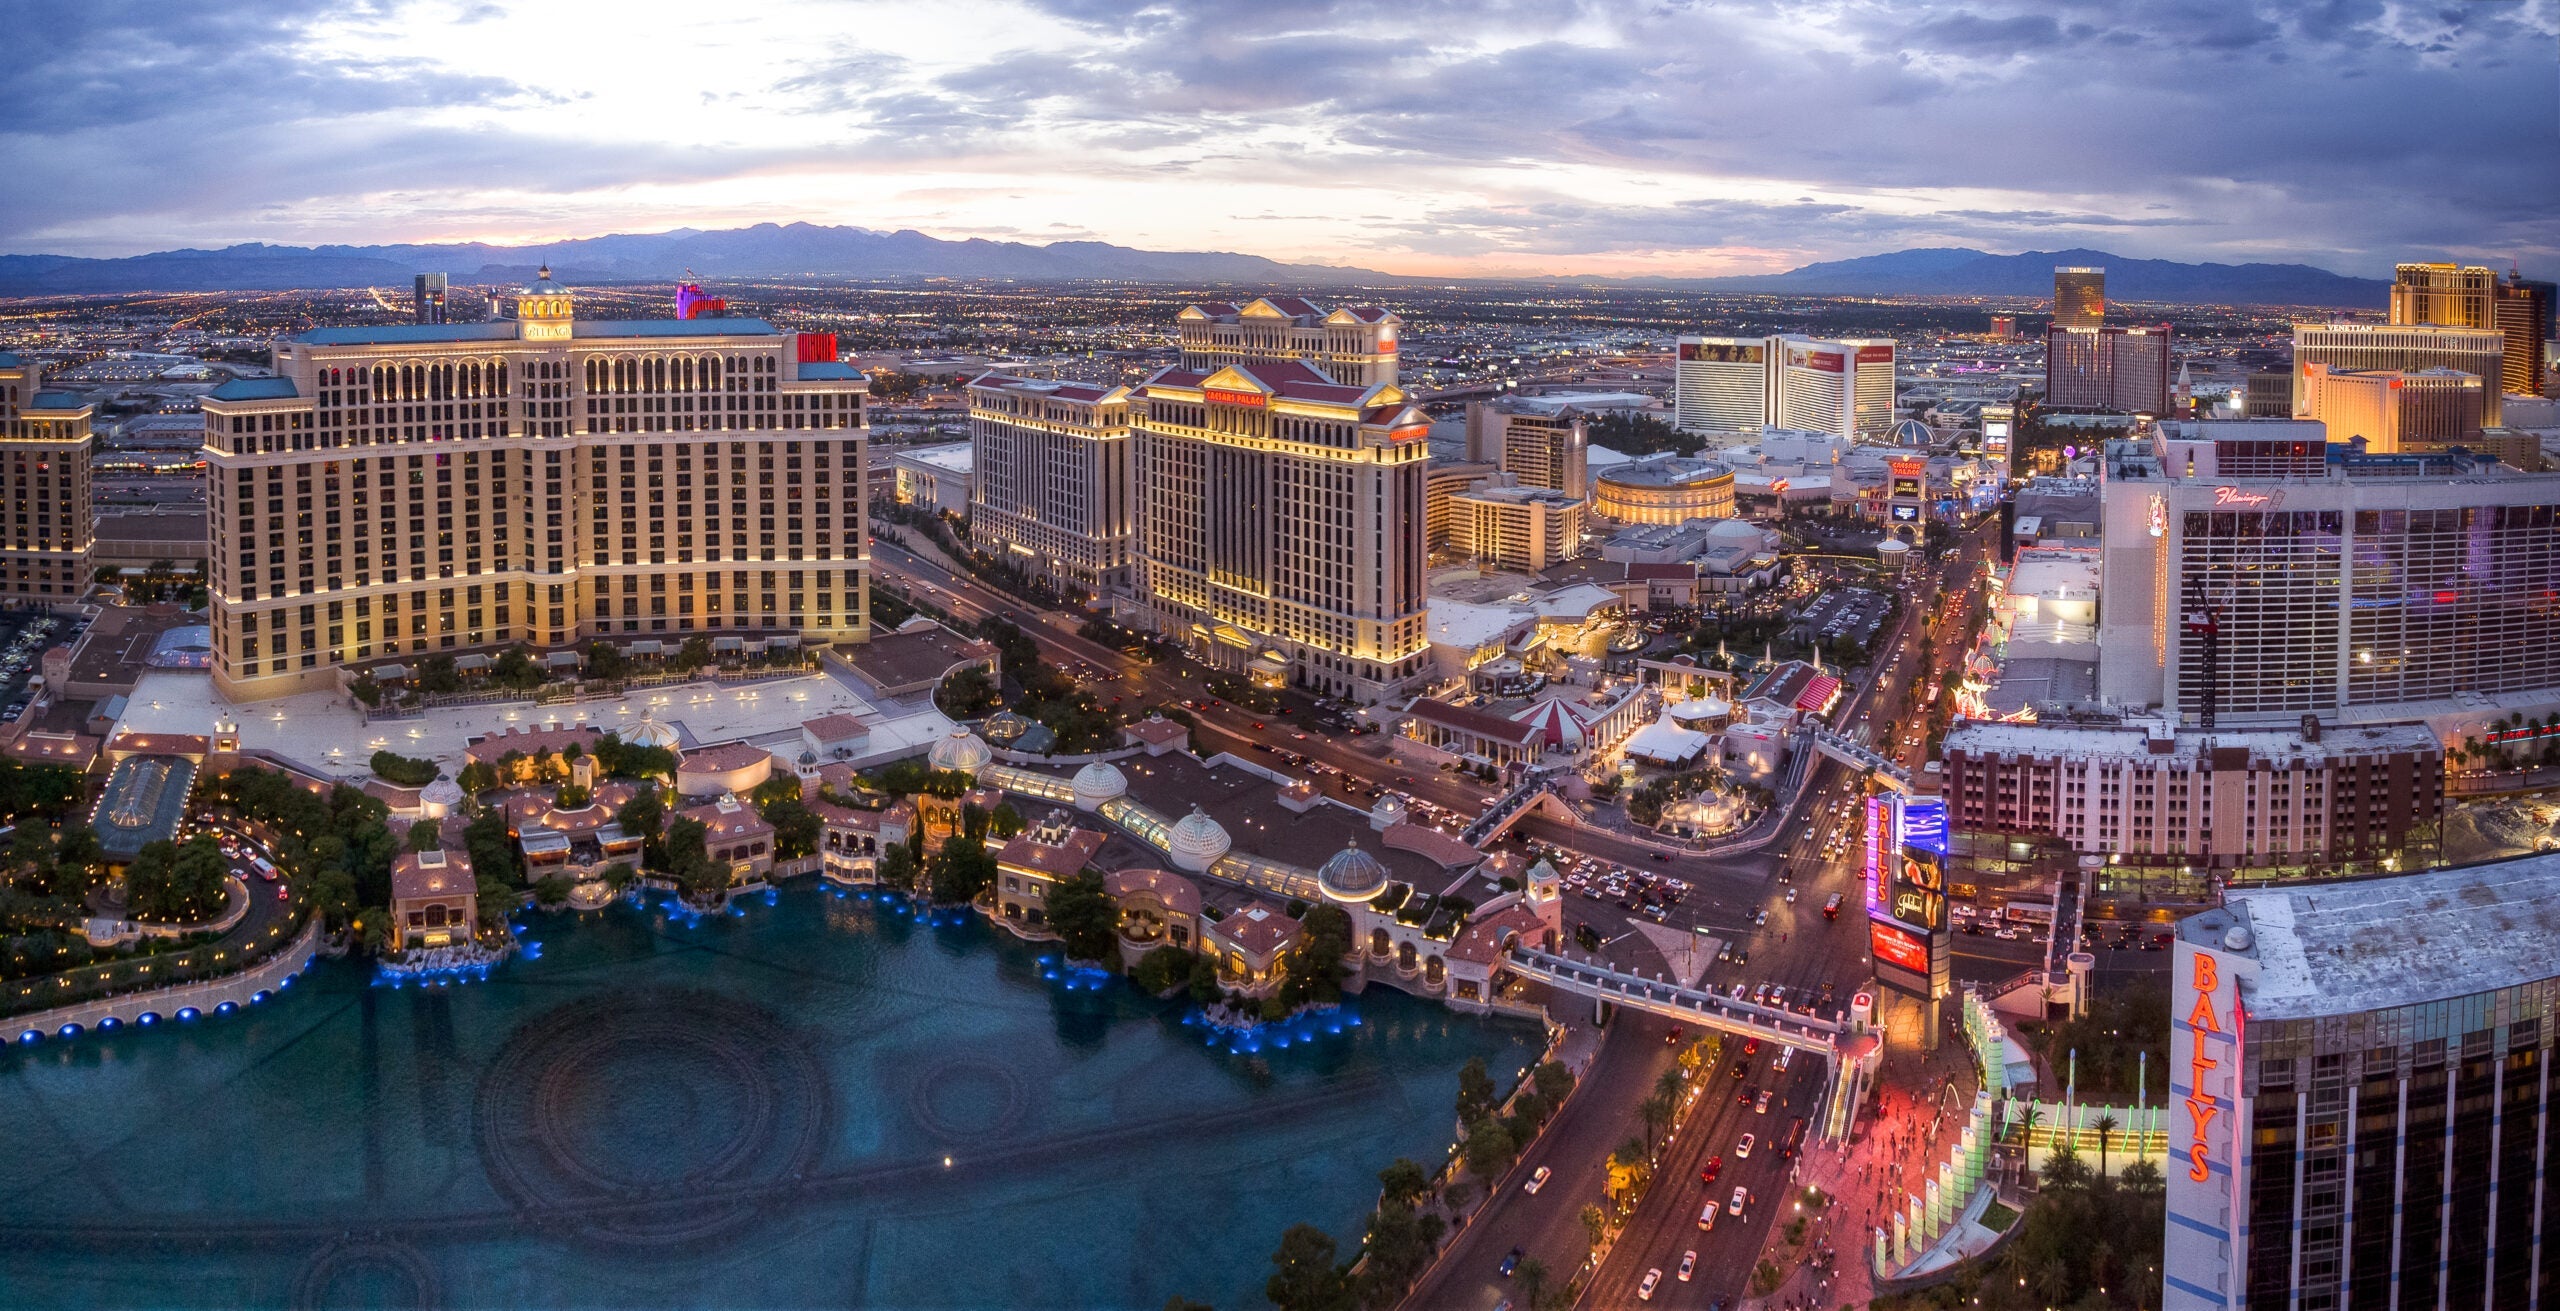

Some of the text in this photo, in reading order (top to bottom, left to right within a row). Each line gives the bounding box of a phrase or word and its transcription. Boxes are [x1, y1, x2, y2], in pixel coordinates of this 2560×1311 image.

[2327, 324, 2373, 332] VENETIAN
[1206, 391, 1265, 406] CAESARS PALACE
[1892, 462, 1921, 470] CAESARS
[1893, 468, 1920, 476] PALACE
[2214, 485, 2269, 507] Flamingo
